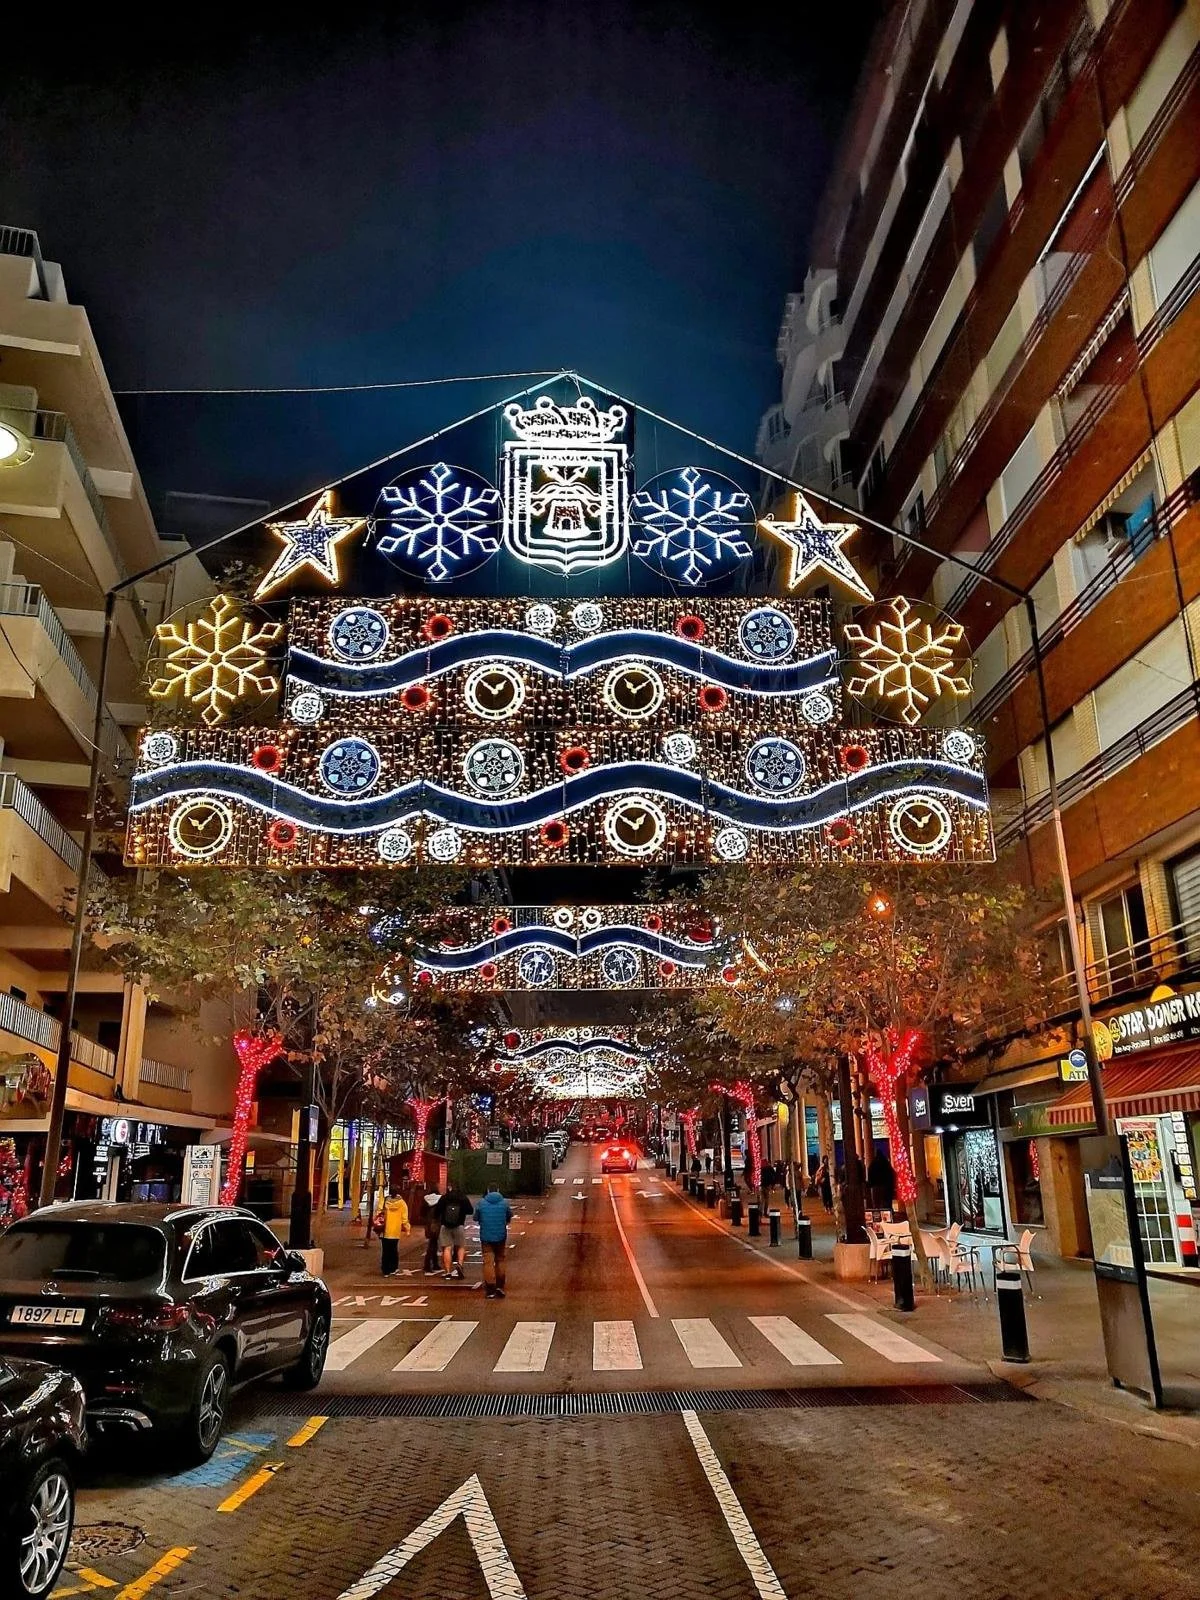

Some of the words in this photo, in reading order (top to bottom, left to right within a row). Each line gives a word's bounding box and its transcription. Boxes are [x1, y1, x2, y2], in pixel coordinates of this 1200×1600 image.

[1118, 1010, 1146, 1038] STAR
[1145, 998, 1187, 1031] DONER
[944, 1094, 975, 1112] Sven
[331, 1295, 429, 1307] TAXI
[18, 1307, 52, 1323] 1897
[54, 1309, 82, 1324] LFL
